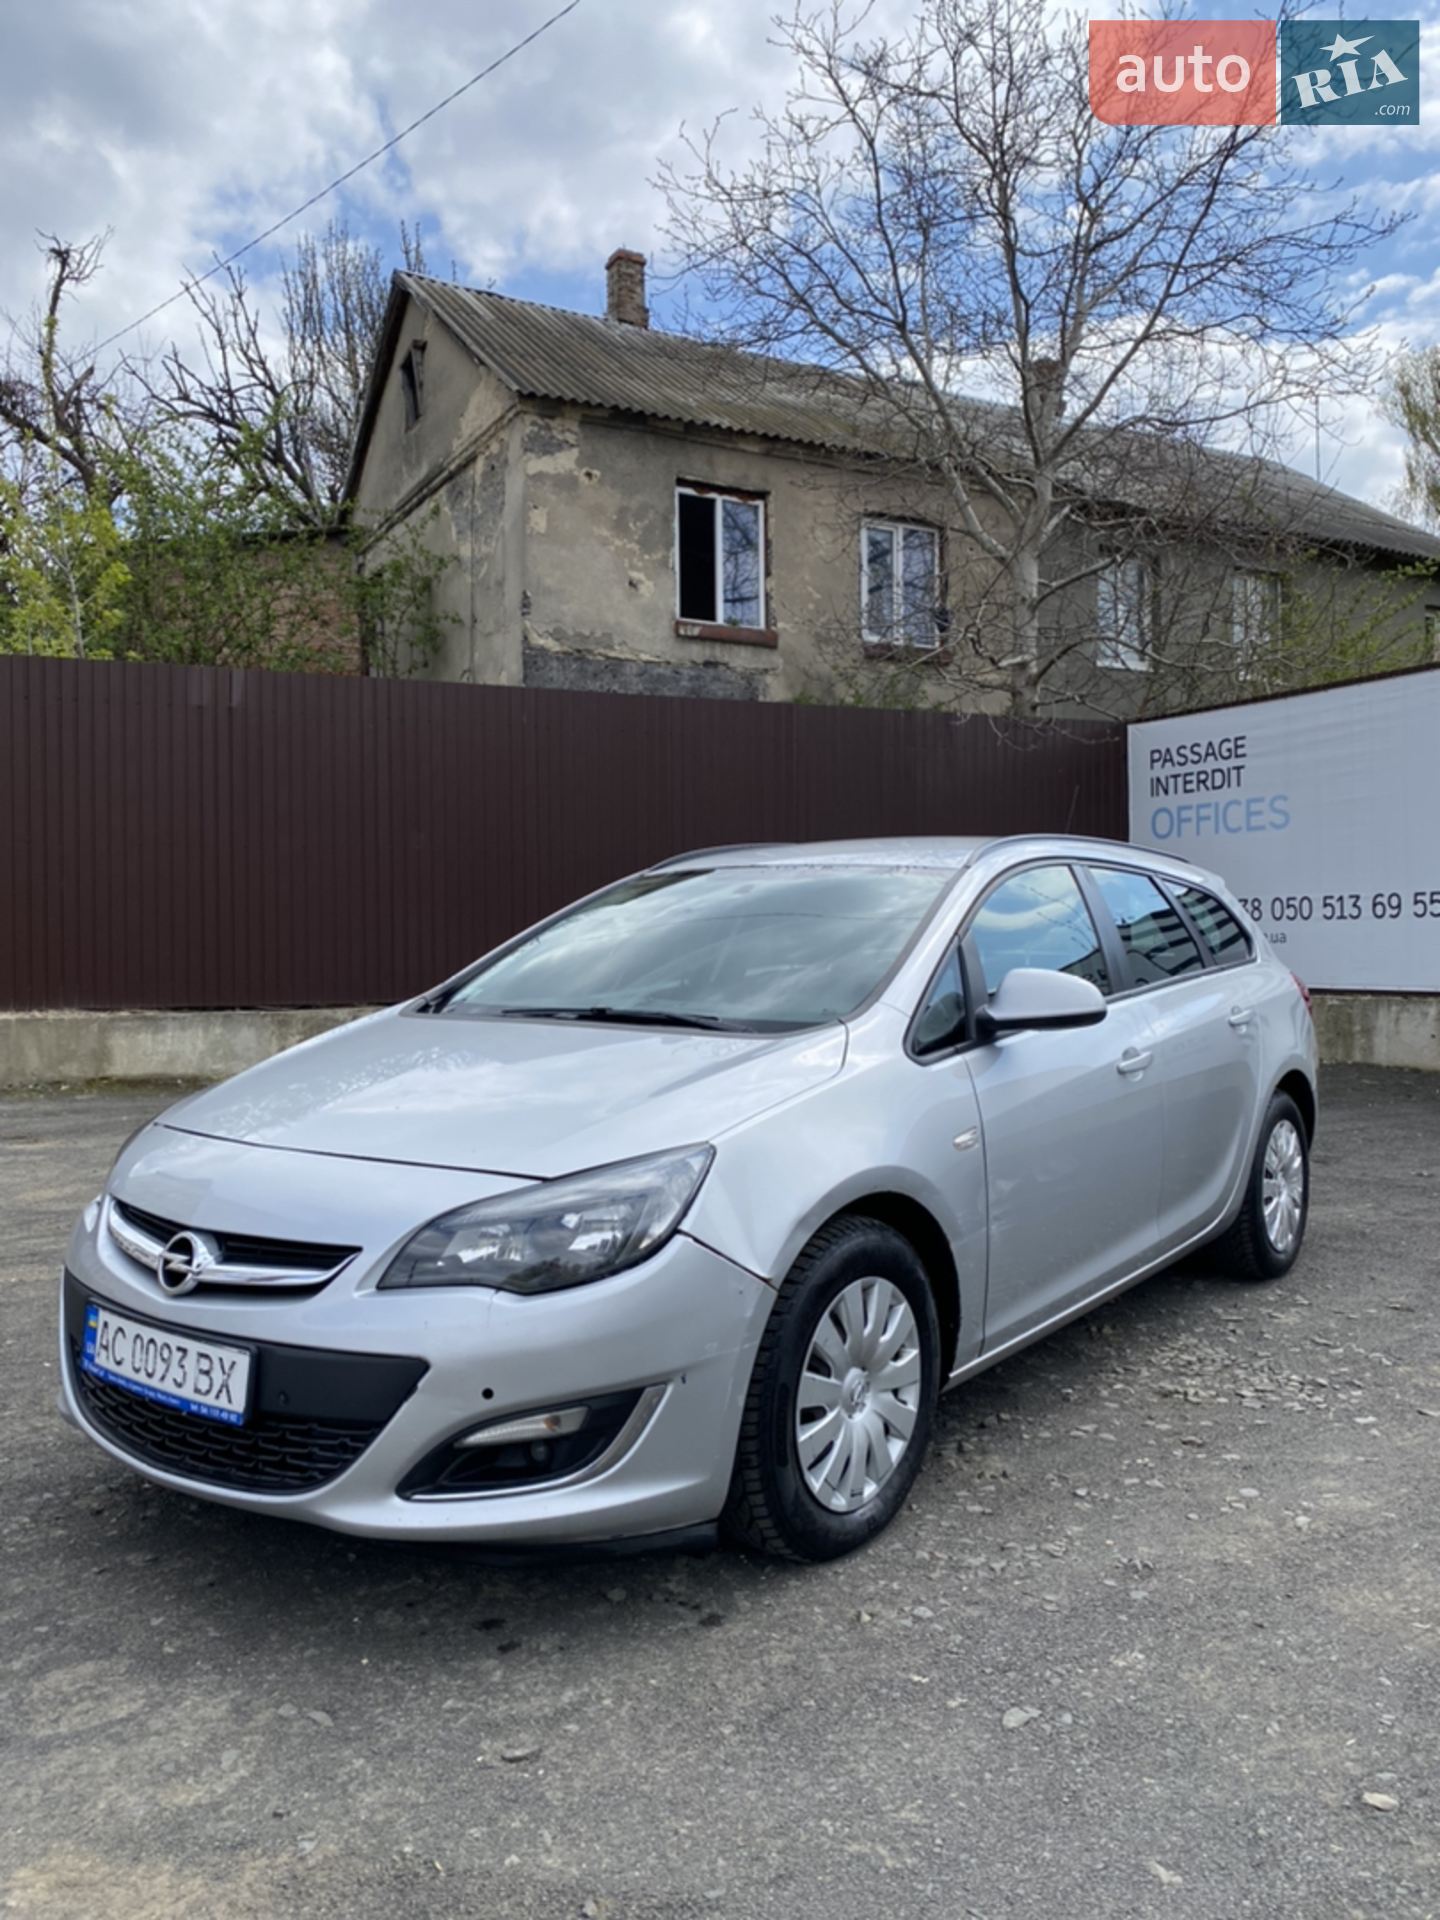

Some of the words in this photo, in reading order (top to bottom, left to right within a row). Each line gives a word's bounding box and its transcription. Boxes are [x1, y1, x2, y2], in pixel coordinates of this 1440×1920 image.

[1150, 735, 1247, 770] PASSAGE
[1150, 765, 1245, 797] INTERDIT
[1151, 794, 1291, 840] OFFICES
[1271, 896, 1313, 922] 050
[1322, 894, 1362, 920] 513
[1371, 891, 1402, 920] 69
[97, 1320, 126, 1366] AC
[131, 1332, 188, 1389] 0093
[193, 1351, 236, 1405] BX
